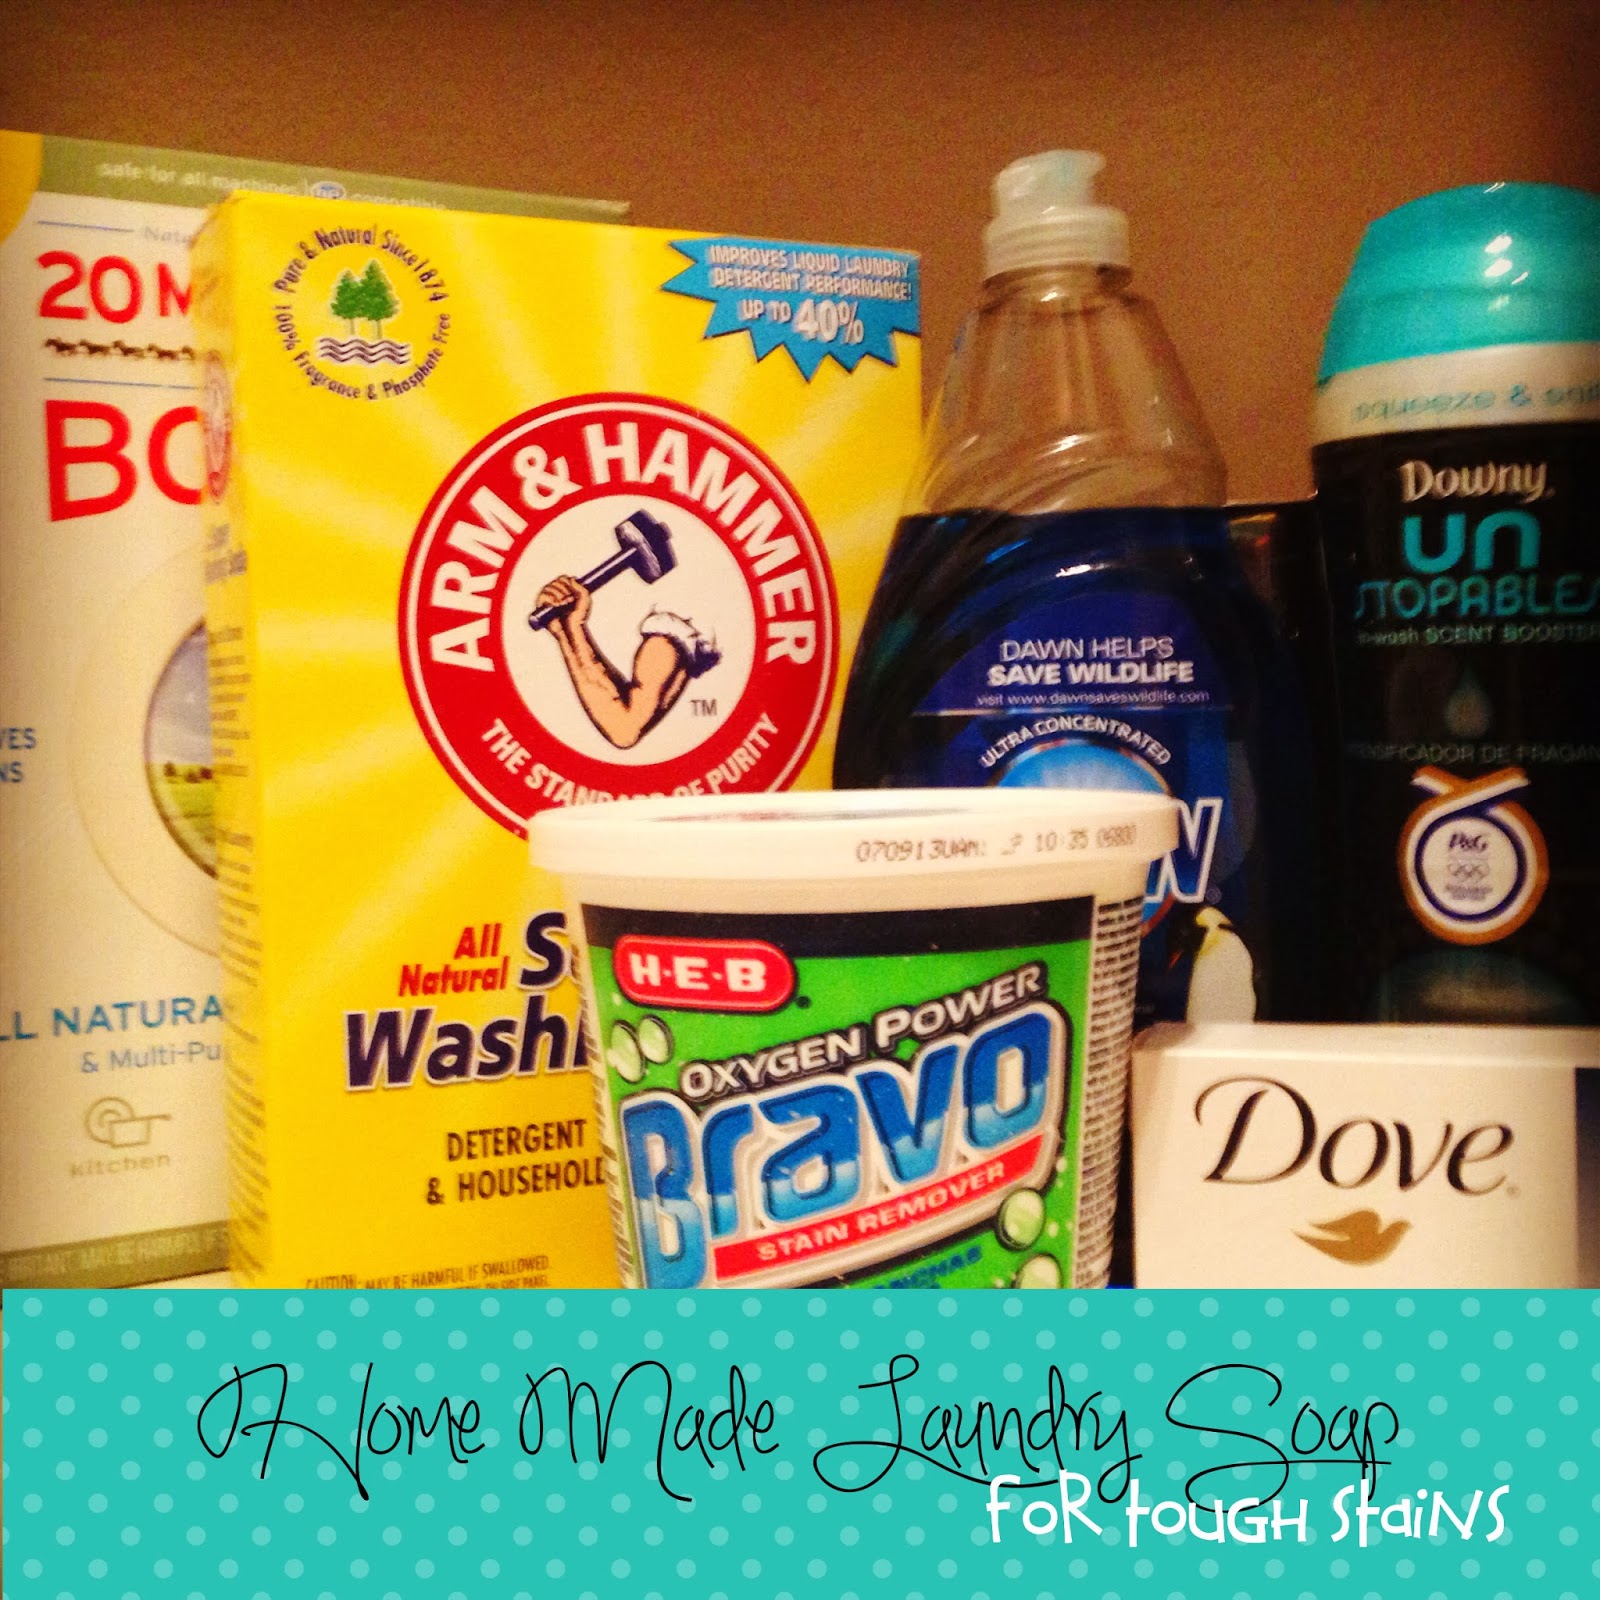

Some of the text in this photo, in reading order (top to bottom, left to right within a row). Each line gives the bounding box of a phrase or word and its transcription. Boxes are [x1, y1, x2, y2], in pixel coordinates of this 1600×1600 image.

[101, 161, 142, 181] safe
[149, 164, 176, 184] for
[273, 223, 450, 302] Pure & Natural Since 1874
[710, 244, 910, 278] IMPROVES LIQUID LAUNDRY
[37, 250, 144, 324] 20
[713, 267, 913, 300] DETERGENT PERFORMANCE!
[740, 298, 865, 344] UP TO 40%
[273, 304, 452, 400] 100% Fragrance & Phosphate Free
[1398, 459, 1550, 504] Downy
[429, 420, 817, 673] ARM & HAMMER
[1000, 636, 1175, 662] DAWN HELPS
[987, 660, 1195, 688] SAVE WILDLIFE
[689, 699, 718, 717] TM
[976, 692, 1004, 708] visit
[481, 718, 533, 775] THE
[705, 711, 780, 795] PURITY
[977, 713, 1173, 769] ULTRA CONCENTRATED
[453, 923, 503, 960] All
[516, 910, 570, 988] S
[398, 956, 510, 996] Natural
[52, 994, 224, 1037] NATURA
[681, 963, 1045, 1100] OXYGEN POWER
[80, 1041, 222, 1074] & Multi-Pu
[446, 1118, 588, 1162] DETERGENT
[622, 1012, 1056, 1289] Bravo
[1193, 1073, 1516, 1197] Dove
[425, 1176, 446, 1206] &
[757, 1160, 1008, 1264] STAIN REMOVER
[410, 1265, 464, 1287] HARMFUL
[467, 1264, 480, 1282] IF
